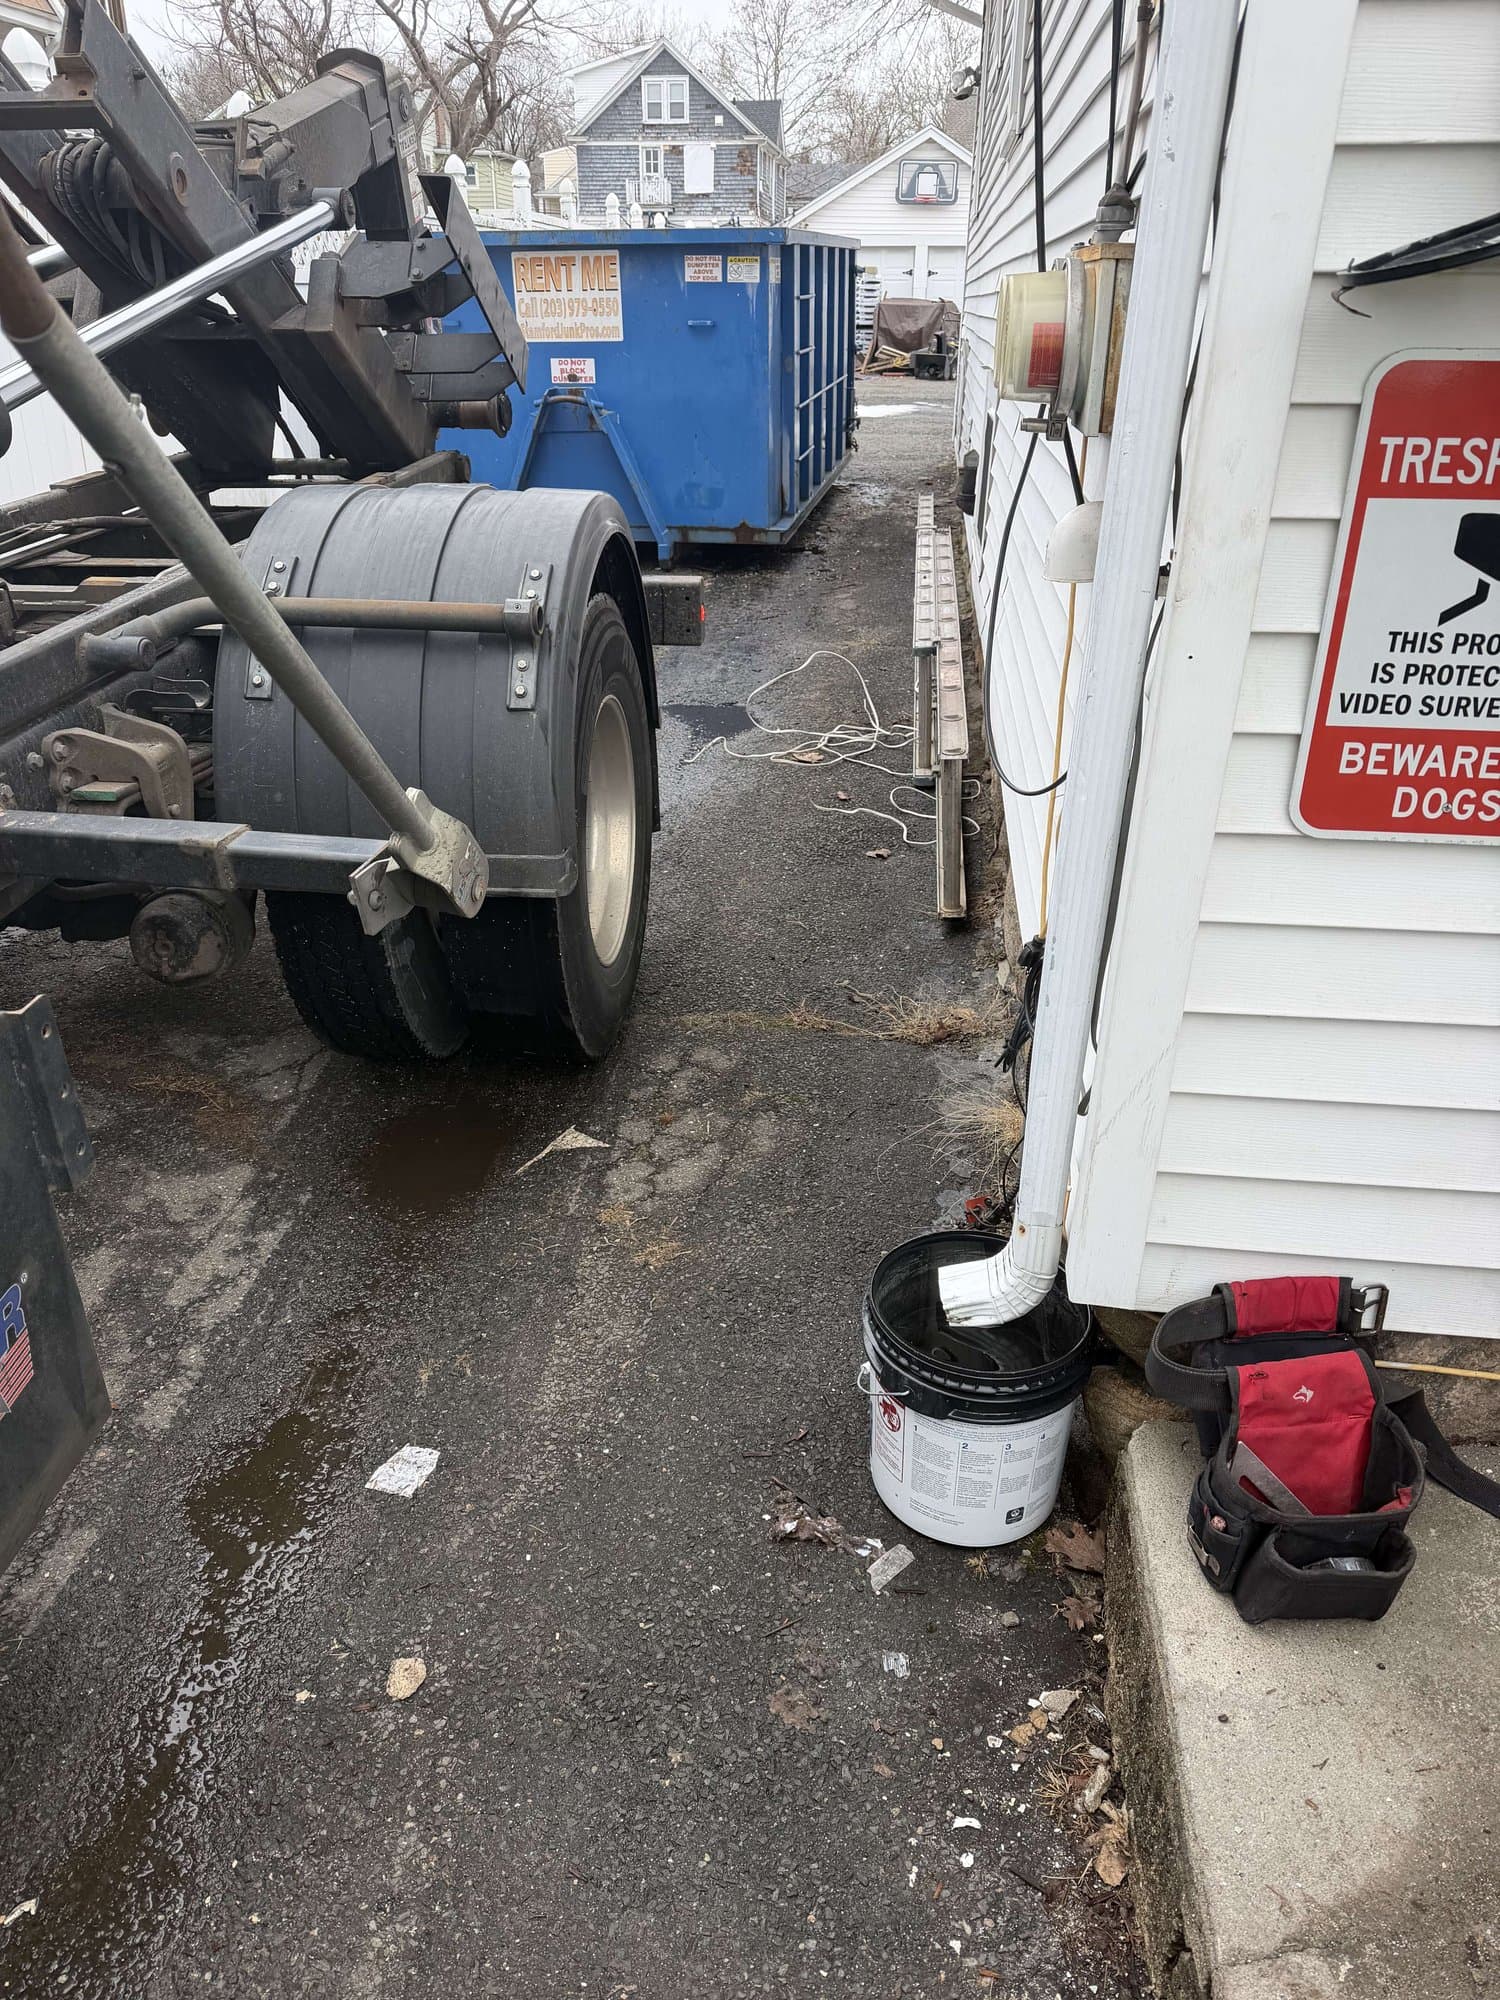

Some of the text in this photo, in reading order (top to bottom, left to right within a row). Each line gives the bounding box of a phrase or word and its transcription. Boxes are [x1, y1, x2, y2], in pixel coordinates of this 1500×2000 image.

[514, 255, 619, 292] RENT ME
[518, 297, 539, 318] Call
[1388, 631, 1500, 656] THIS PRO
[1370, 662, 1500, 687] IS PROTEC
[1339, 692, 1500, 718] VIDEO SURVE
[1338, 741, 1500, 779] BEWARE
[1391, 786, 1500, 822] DOGS
